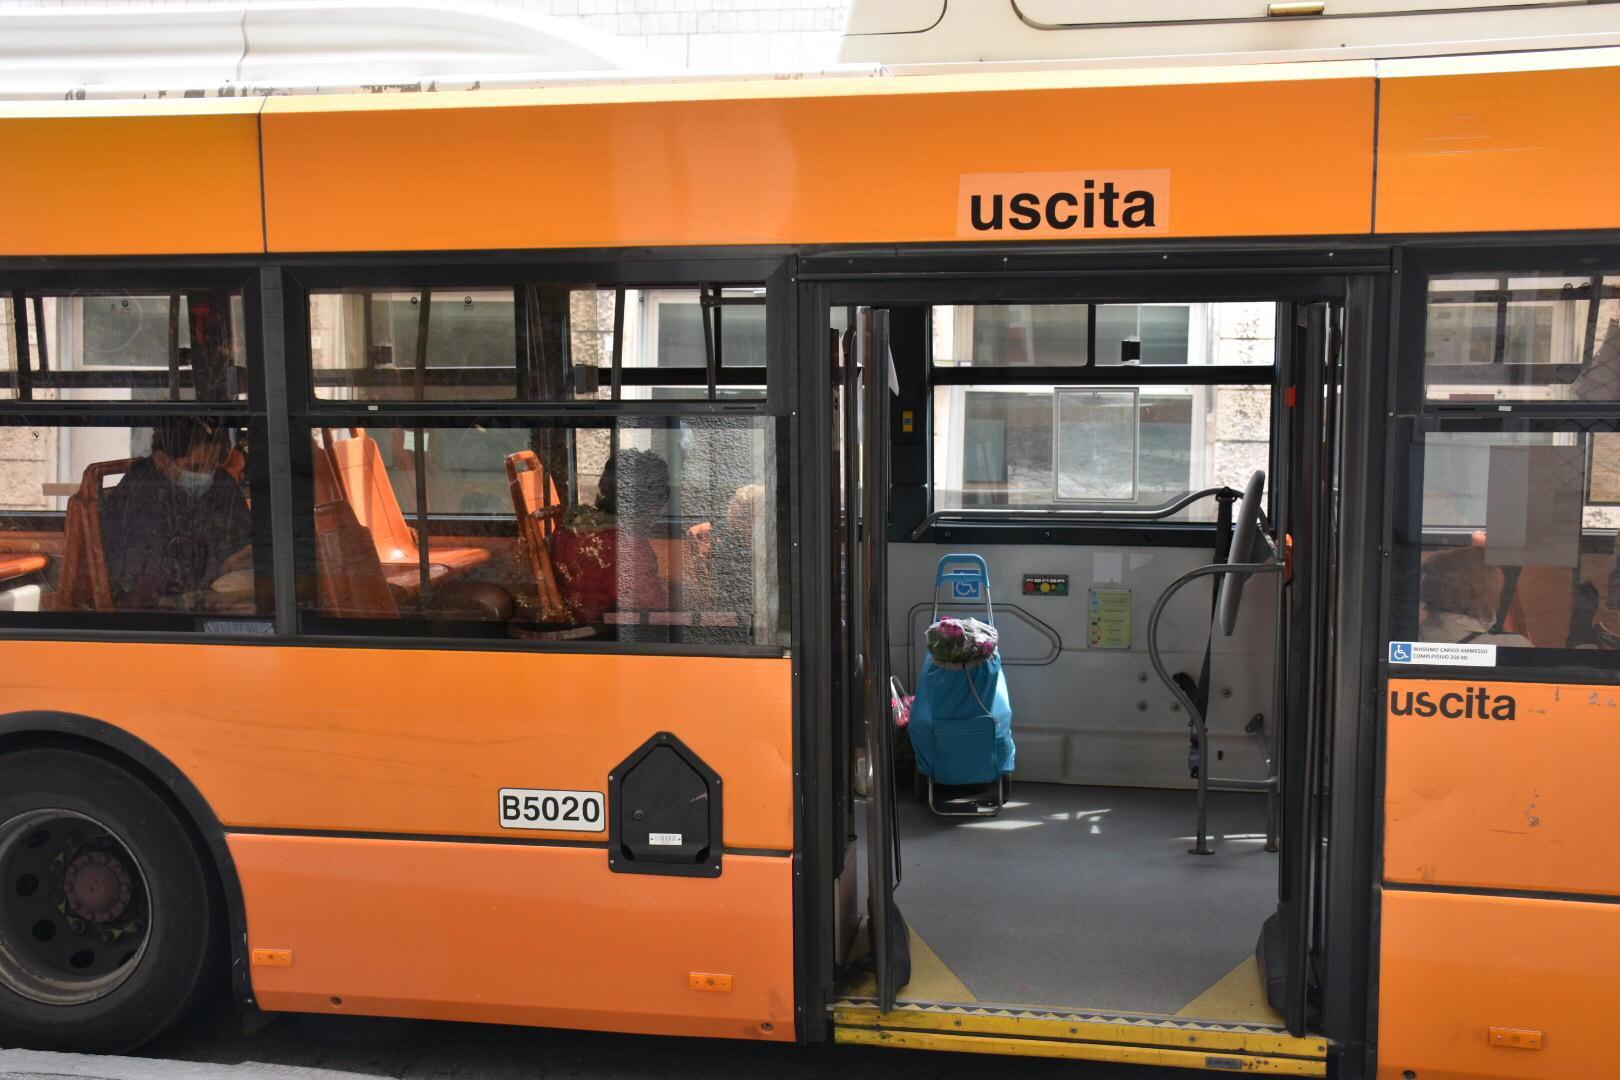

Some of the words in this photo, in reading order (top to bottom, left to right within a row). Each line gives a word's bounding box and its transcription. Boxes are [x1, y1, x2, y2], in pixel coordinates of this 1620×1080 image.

[970, 179, 1156, 231] uscita
[1390, 686, 1516, 721] uscita
[502, 795, 600, 823] B5020
